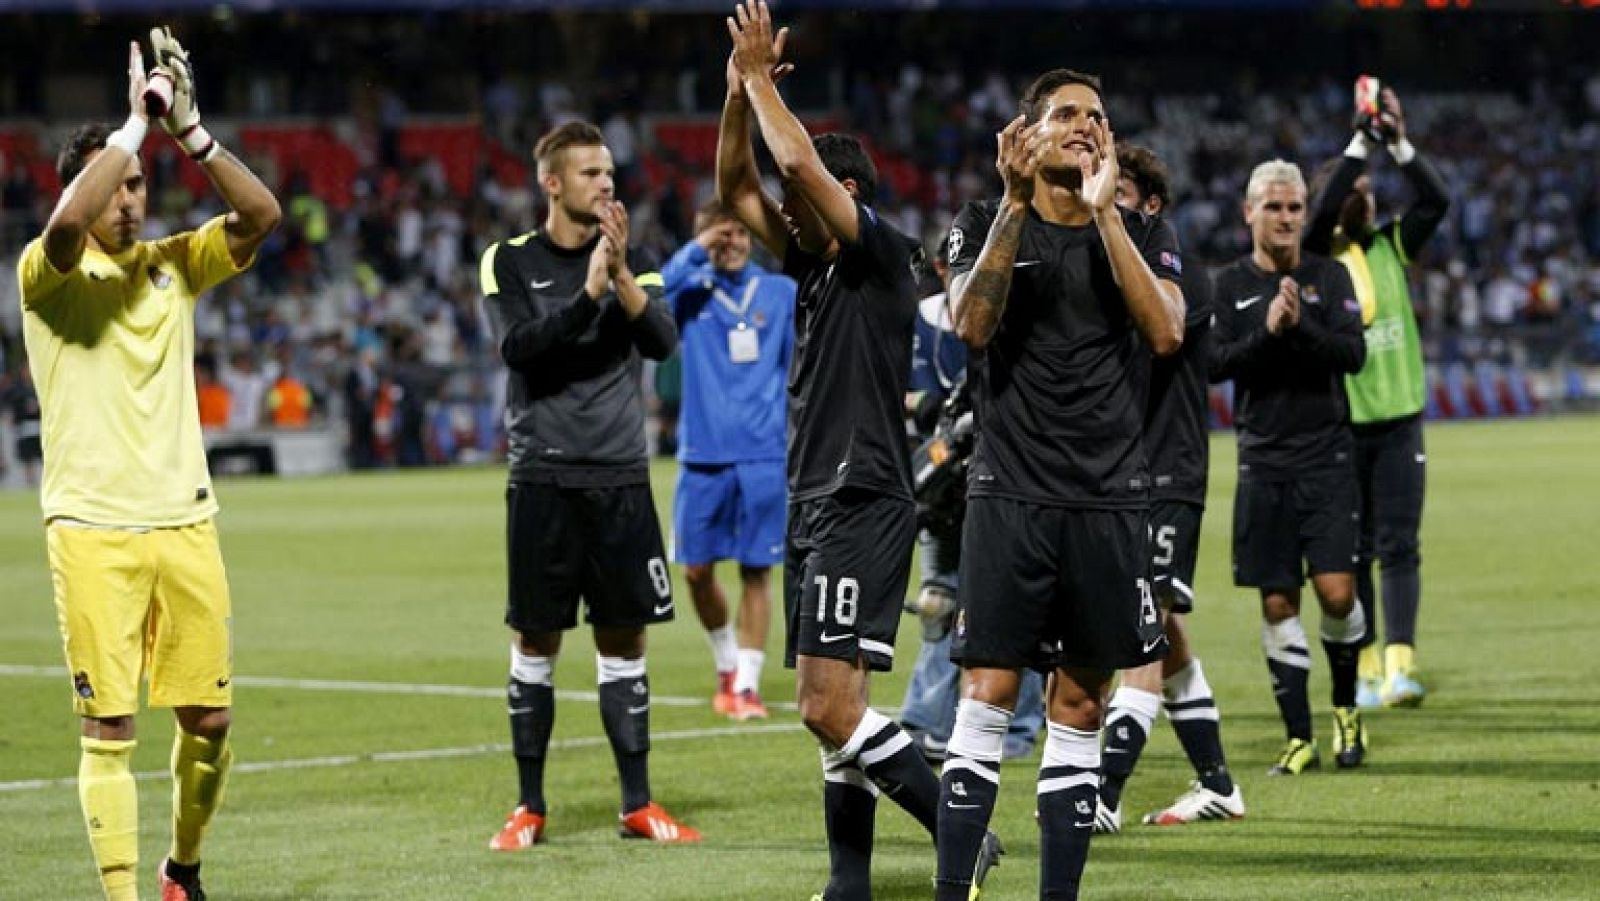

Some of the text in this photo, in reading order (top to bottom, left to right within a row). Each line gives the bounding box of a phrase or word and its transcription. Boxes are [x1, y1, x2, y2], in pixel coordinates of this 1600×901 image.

[1147, 523, 1176, 565] 5
[648, 557, 670, 598] 8
[814, 575, 860, 626] 18
